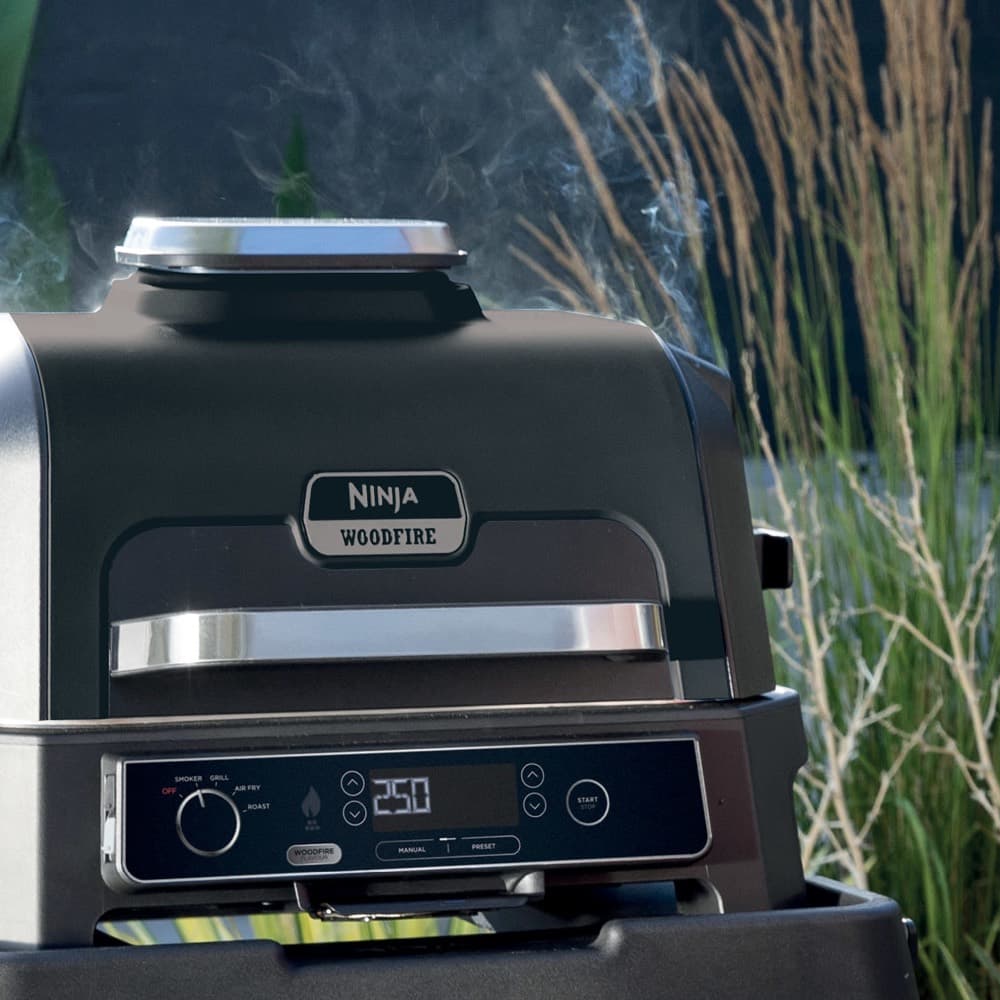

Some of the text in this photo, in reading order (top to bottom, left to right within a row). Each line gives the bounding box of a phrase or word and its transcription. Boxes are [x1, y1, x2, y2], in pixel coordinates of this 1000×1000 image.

[348, 482, 419, 514] NINJA
[340, 528, 437, 546] WOODFIRE
[162, 787, 177, 795] OFF
[373, 777, 431, 816] 250
[294, 847, 335, 856] WOODFIRE
[471, 842, 496, 850] PRESET
